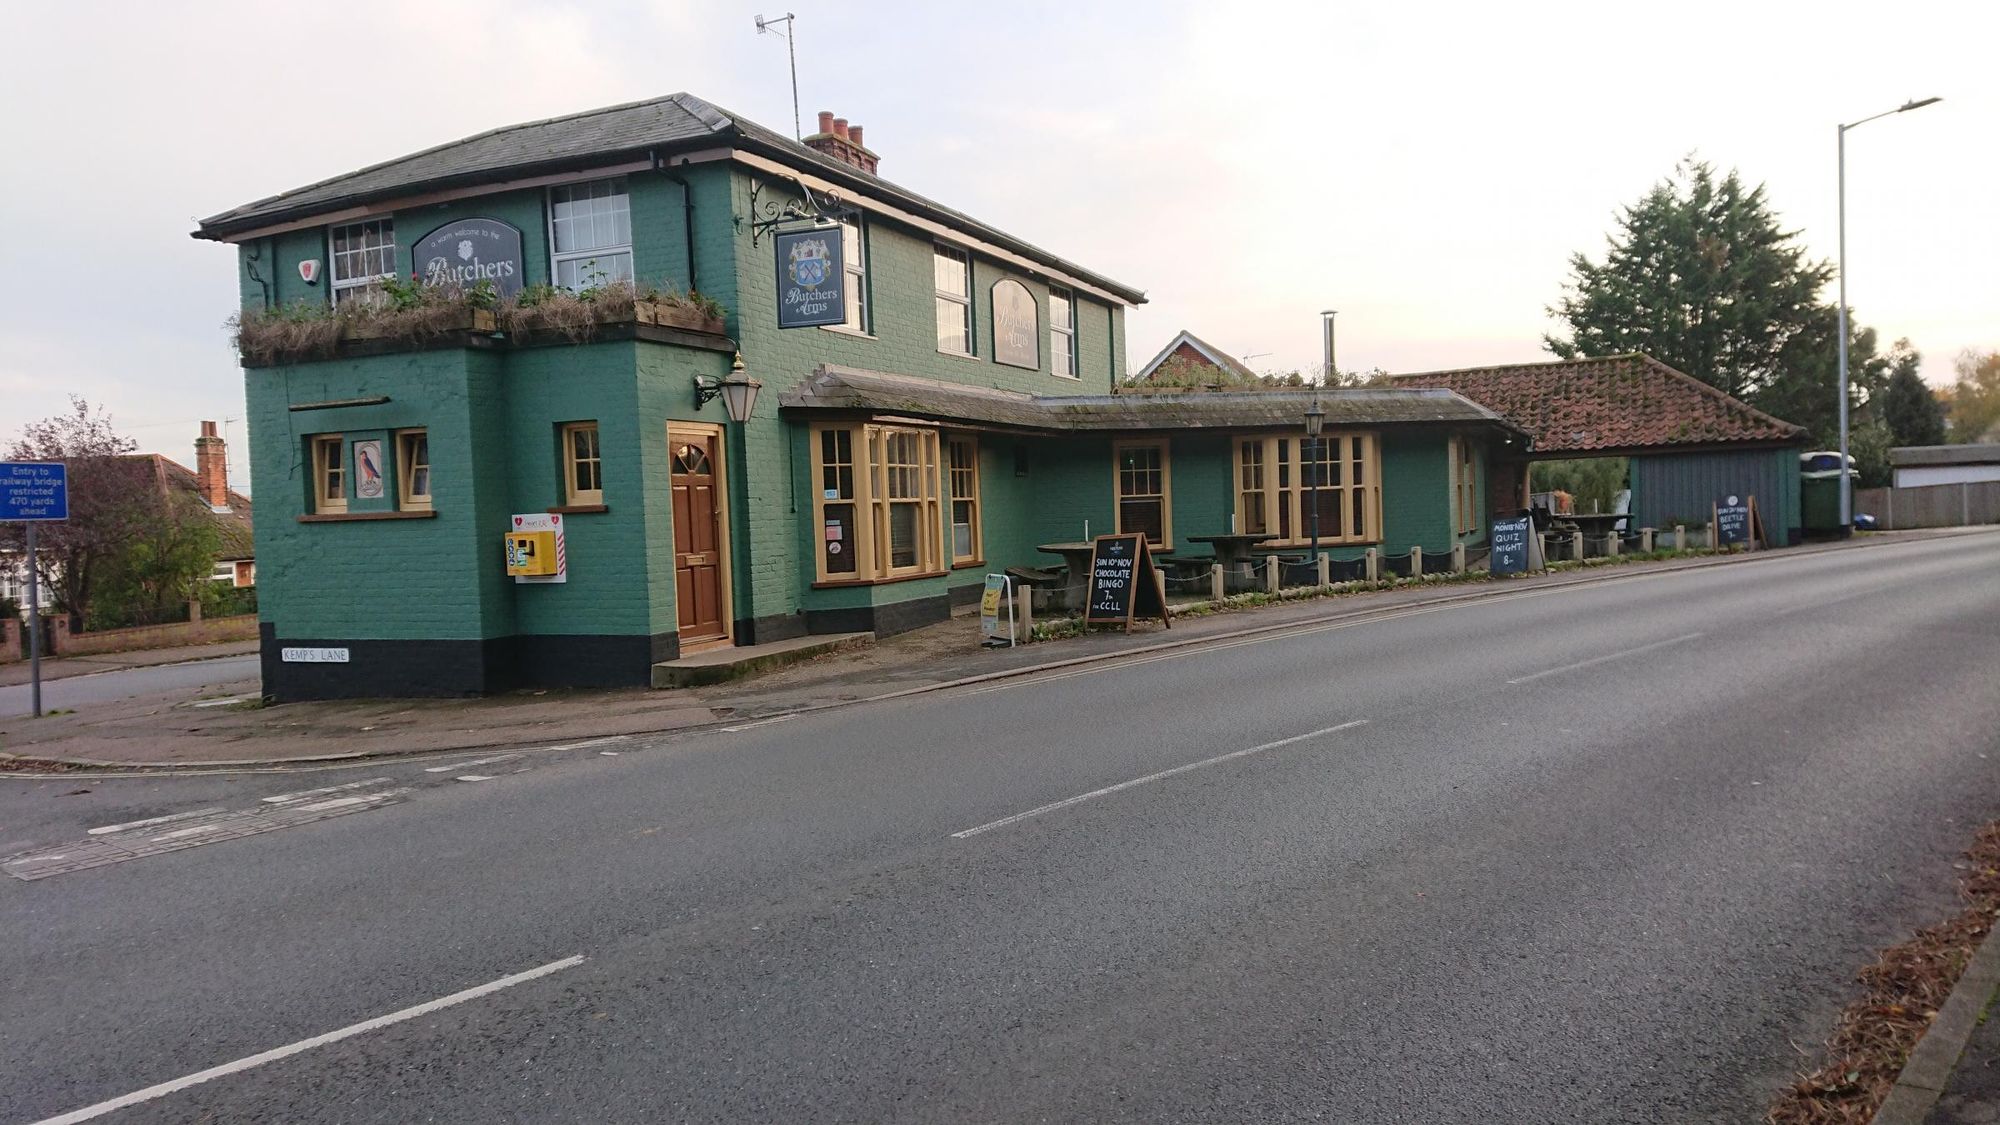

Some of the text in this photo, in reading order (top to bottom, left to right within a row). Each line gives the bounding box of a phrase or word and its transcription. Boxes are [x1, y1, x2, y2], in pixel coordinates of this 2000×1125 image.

[438, 233, 453, 244] warm
[455, 228, 480, 236] welcome
[491, 231, 500, 240] the
[423, 256, 513, 288] Butchers
[785, 287, 838, 304] Butchers
[796, 300, 828, 315] Arms
[12, 466, 49, 477] Entry to
[34, 477, 63, 487] bridge
[9, 487, 54, 496] restricted
[8, 496, 55, 507] 470 yards
[19, 507, 47, 515] ahead
[1515, 522, 1528, 530] NOV
[1495, 533, 1520, 543] QUIZ
[1496, 543, 1523, 552] NIGHT
[1096, 558, 1108, 567] SUN
[1117, 558, 1132, 567] NOV
[1094, 569, 1131, 579] CHOCOLATE
[1098, 578, 1123, 589] BINGO
[284, 649, 347, 661] KEMP'S LANE
